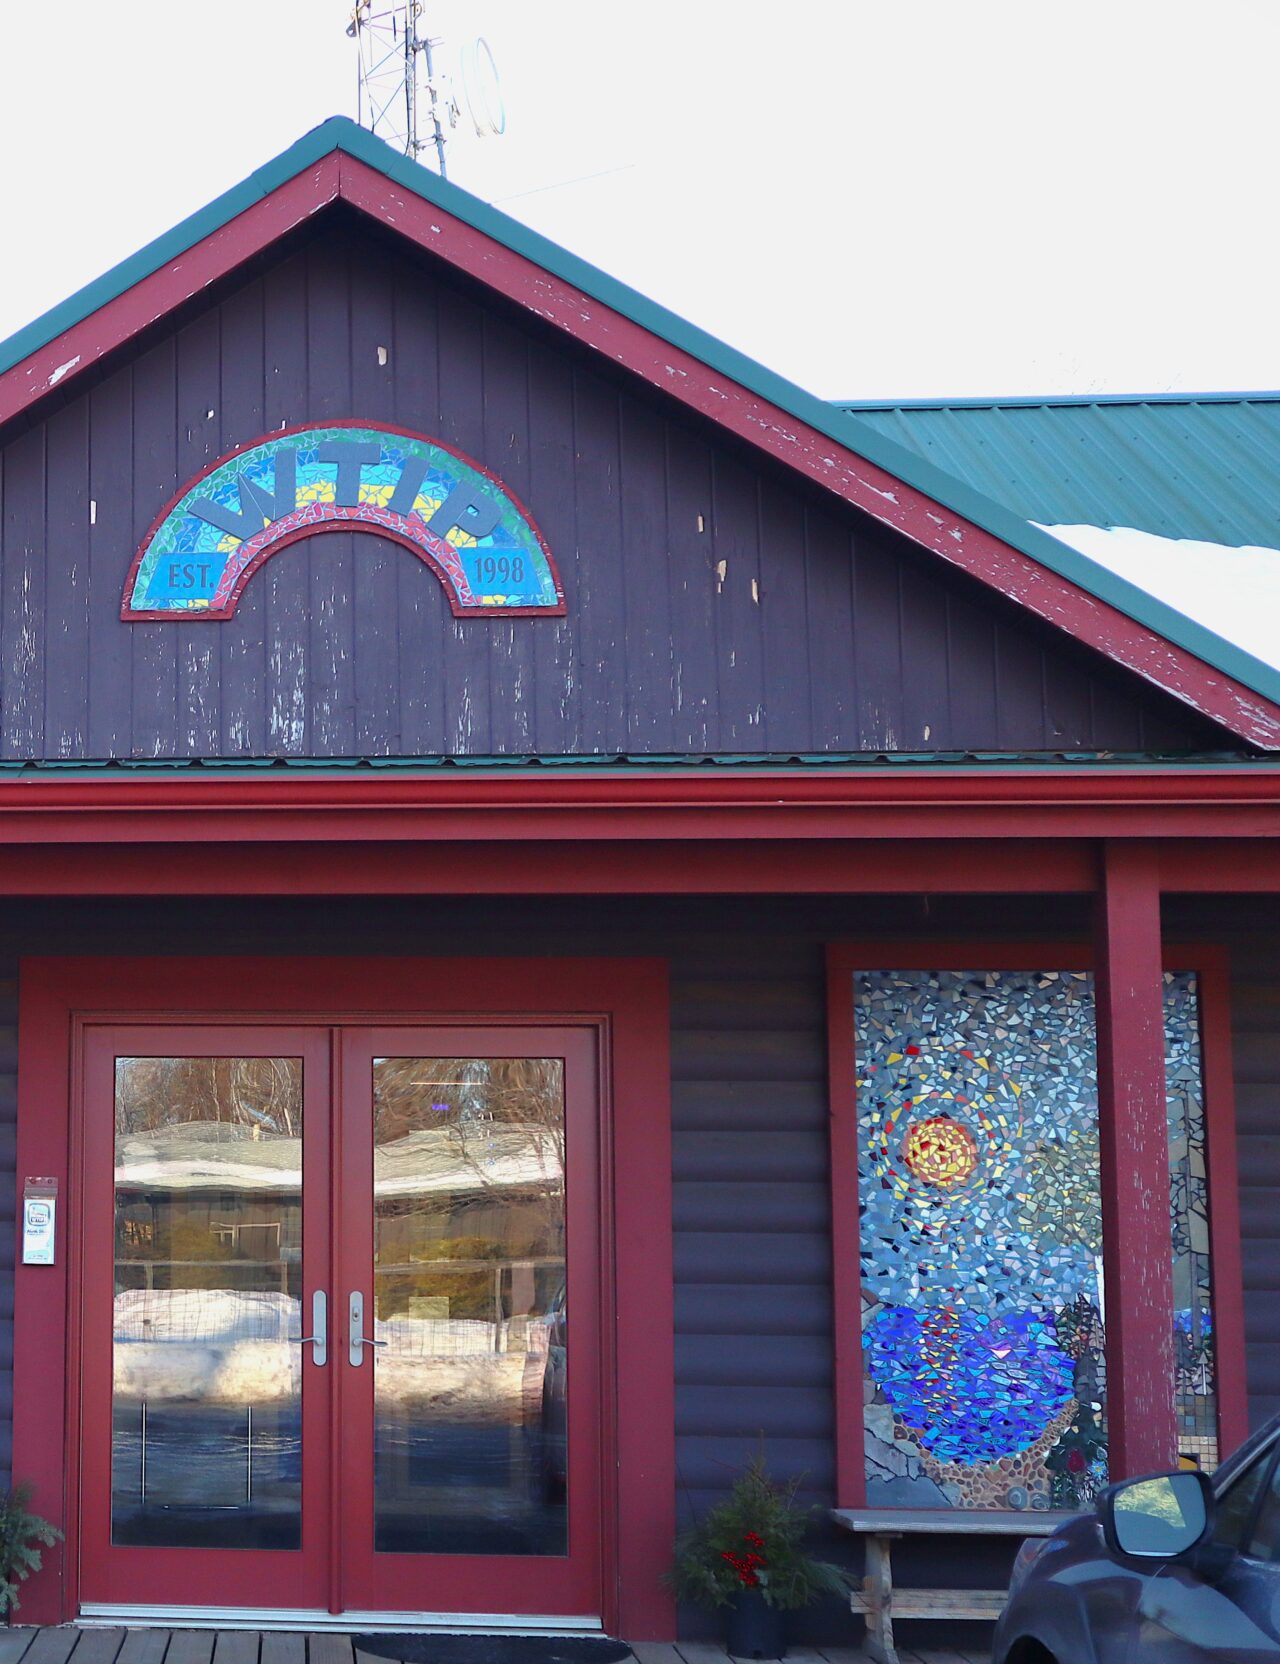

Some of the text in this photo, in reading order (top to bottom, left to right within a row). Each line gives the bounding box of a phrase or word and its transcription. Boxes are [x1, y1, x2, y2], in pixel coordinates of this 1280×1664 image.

[188, 441, 502, 543] WTIP
[168, 564, 215, 588] EST.
[474, 557, 524, 584] 1998
